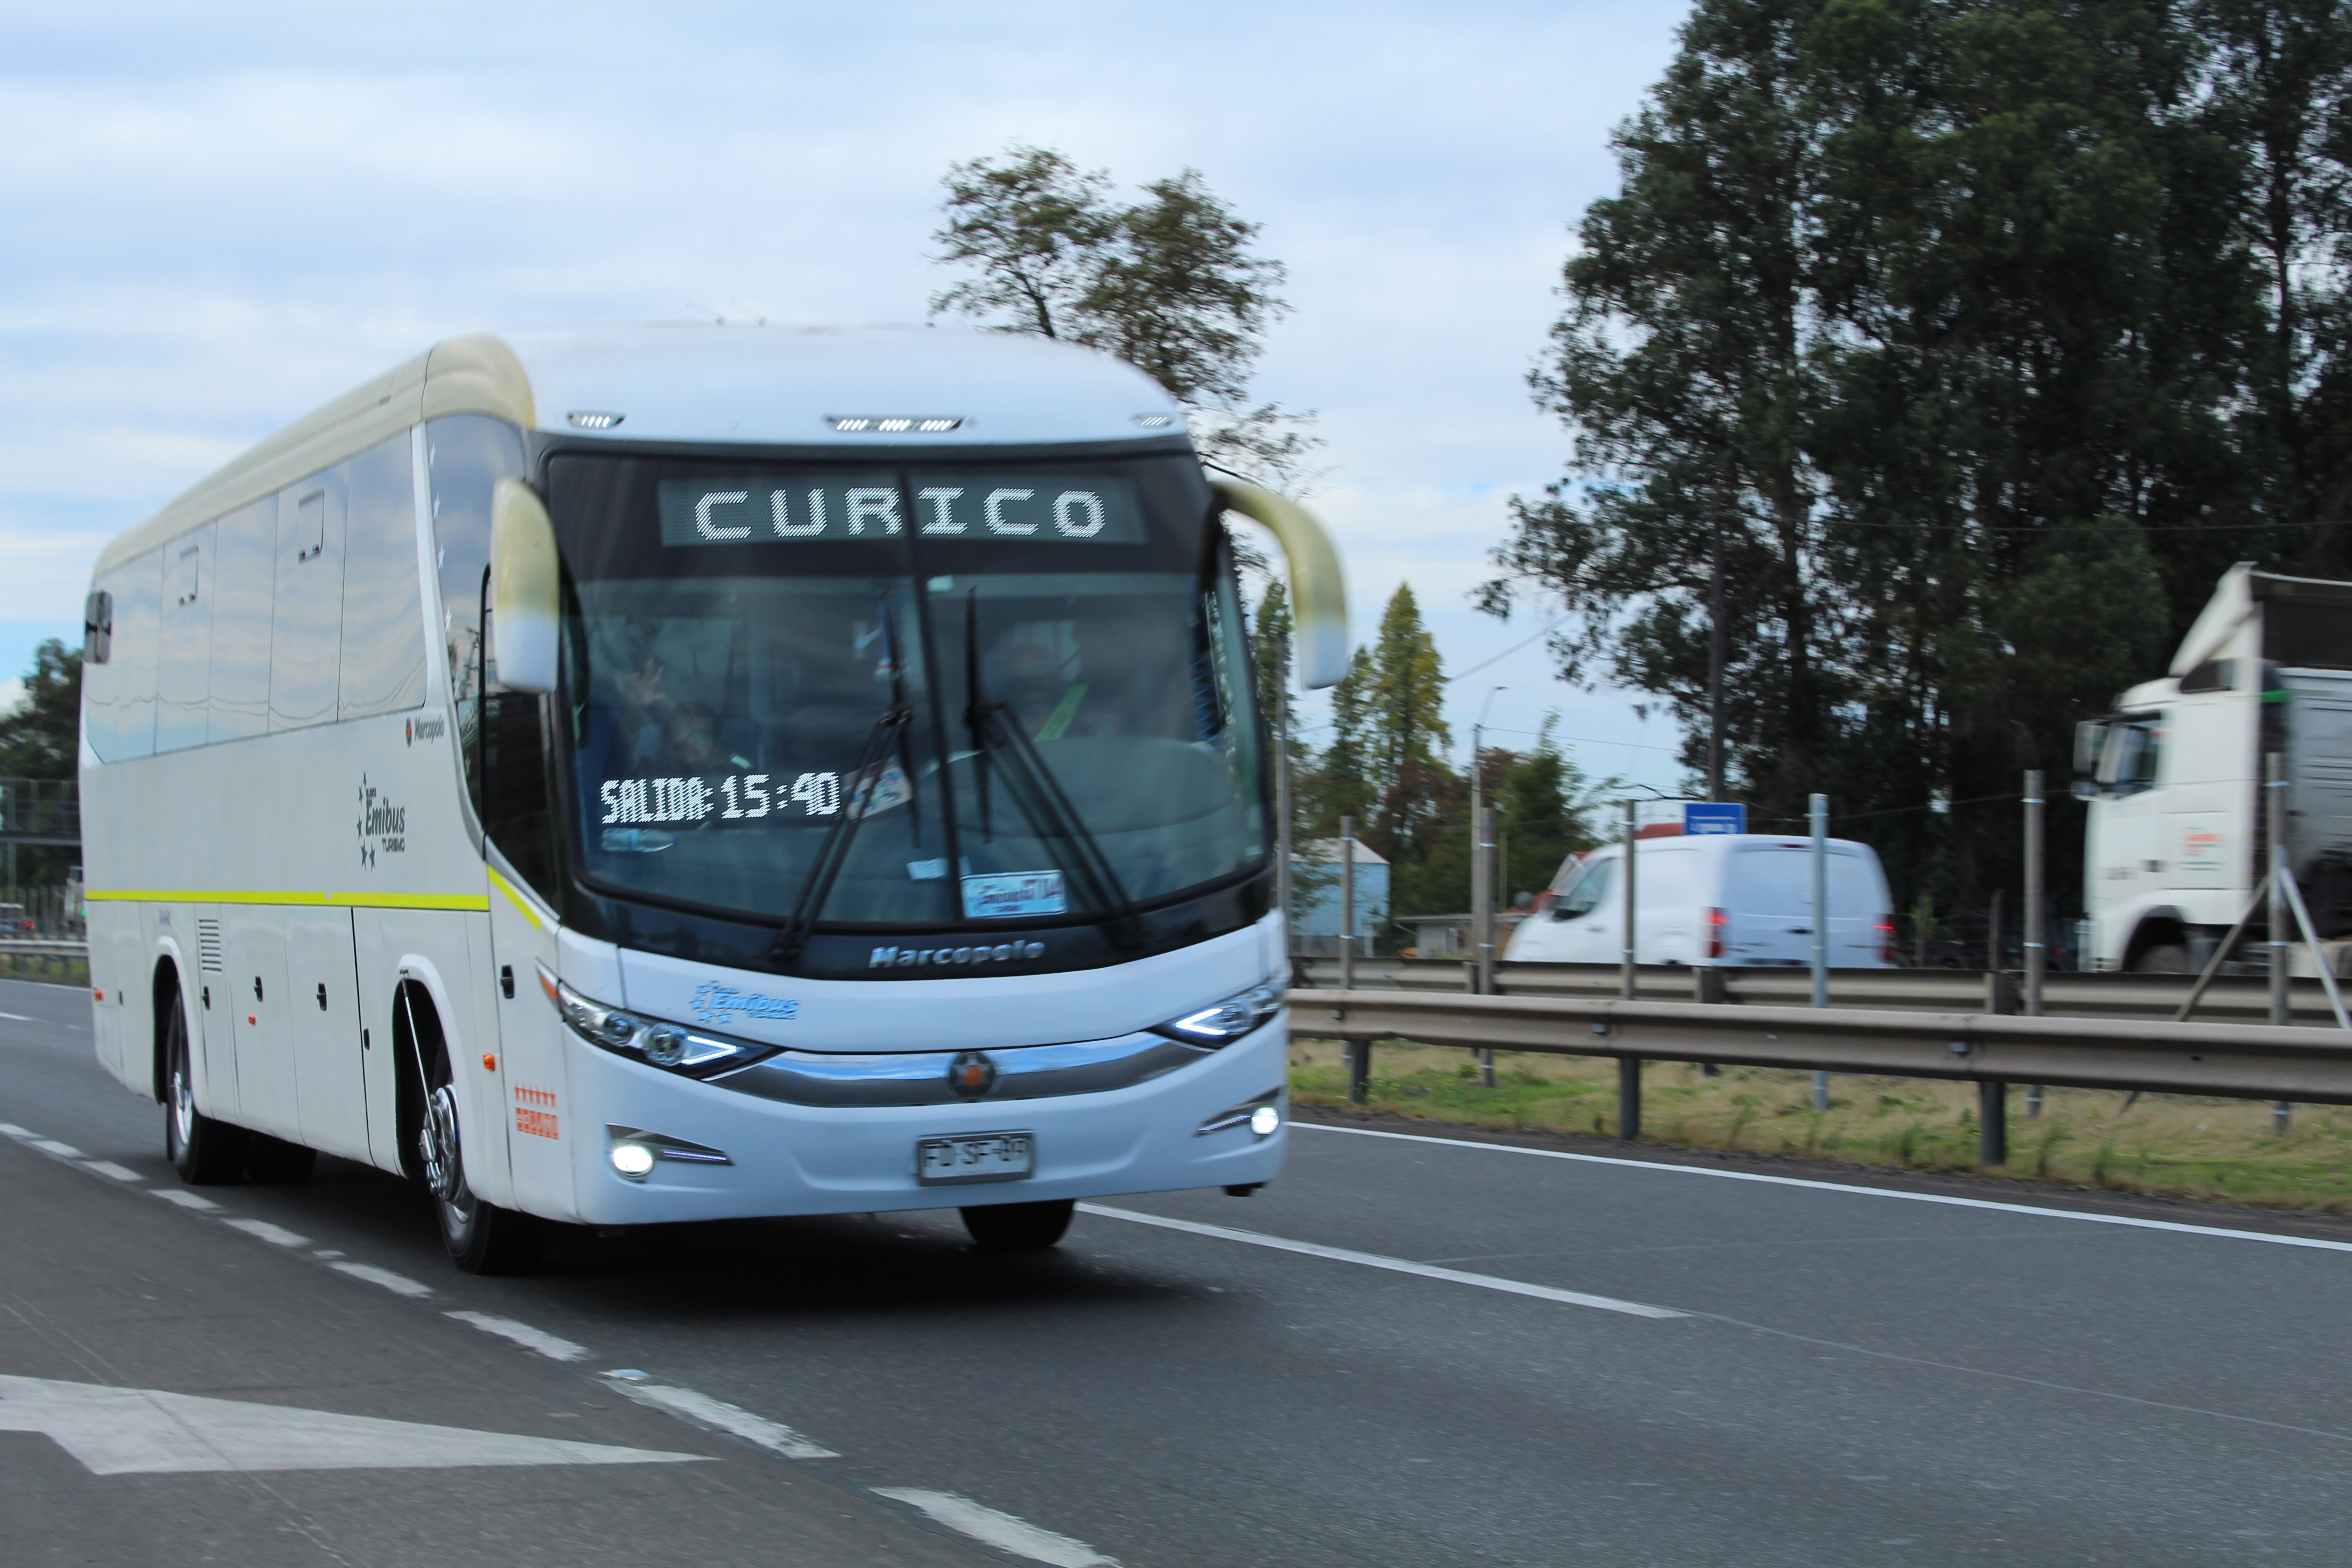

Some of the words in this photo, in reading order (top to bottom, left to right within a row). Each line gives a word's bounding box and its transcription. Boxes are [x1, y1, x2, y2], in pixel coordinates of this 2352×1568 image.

[695, 487, 1106, 540] CURICO
[720, 771, 841, 818] 15:40
[366, 796, 405, 836] Emibus
[382, 838, 405, 853] TURISMO
[868, 939, 1045, 969] Marcopolo
